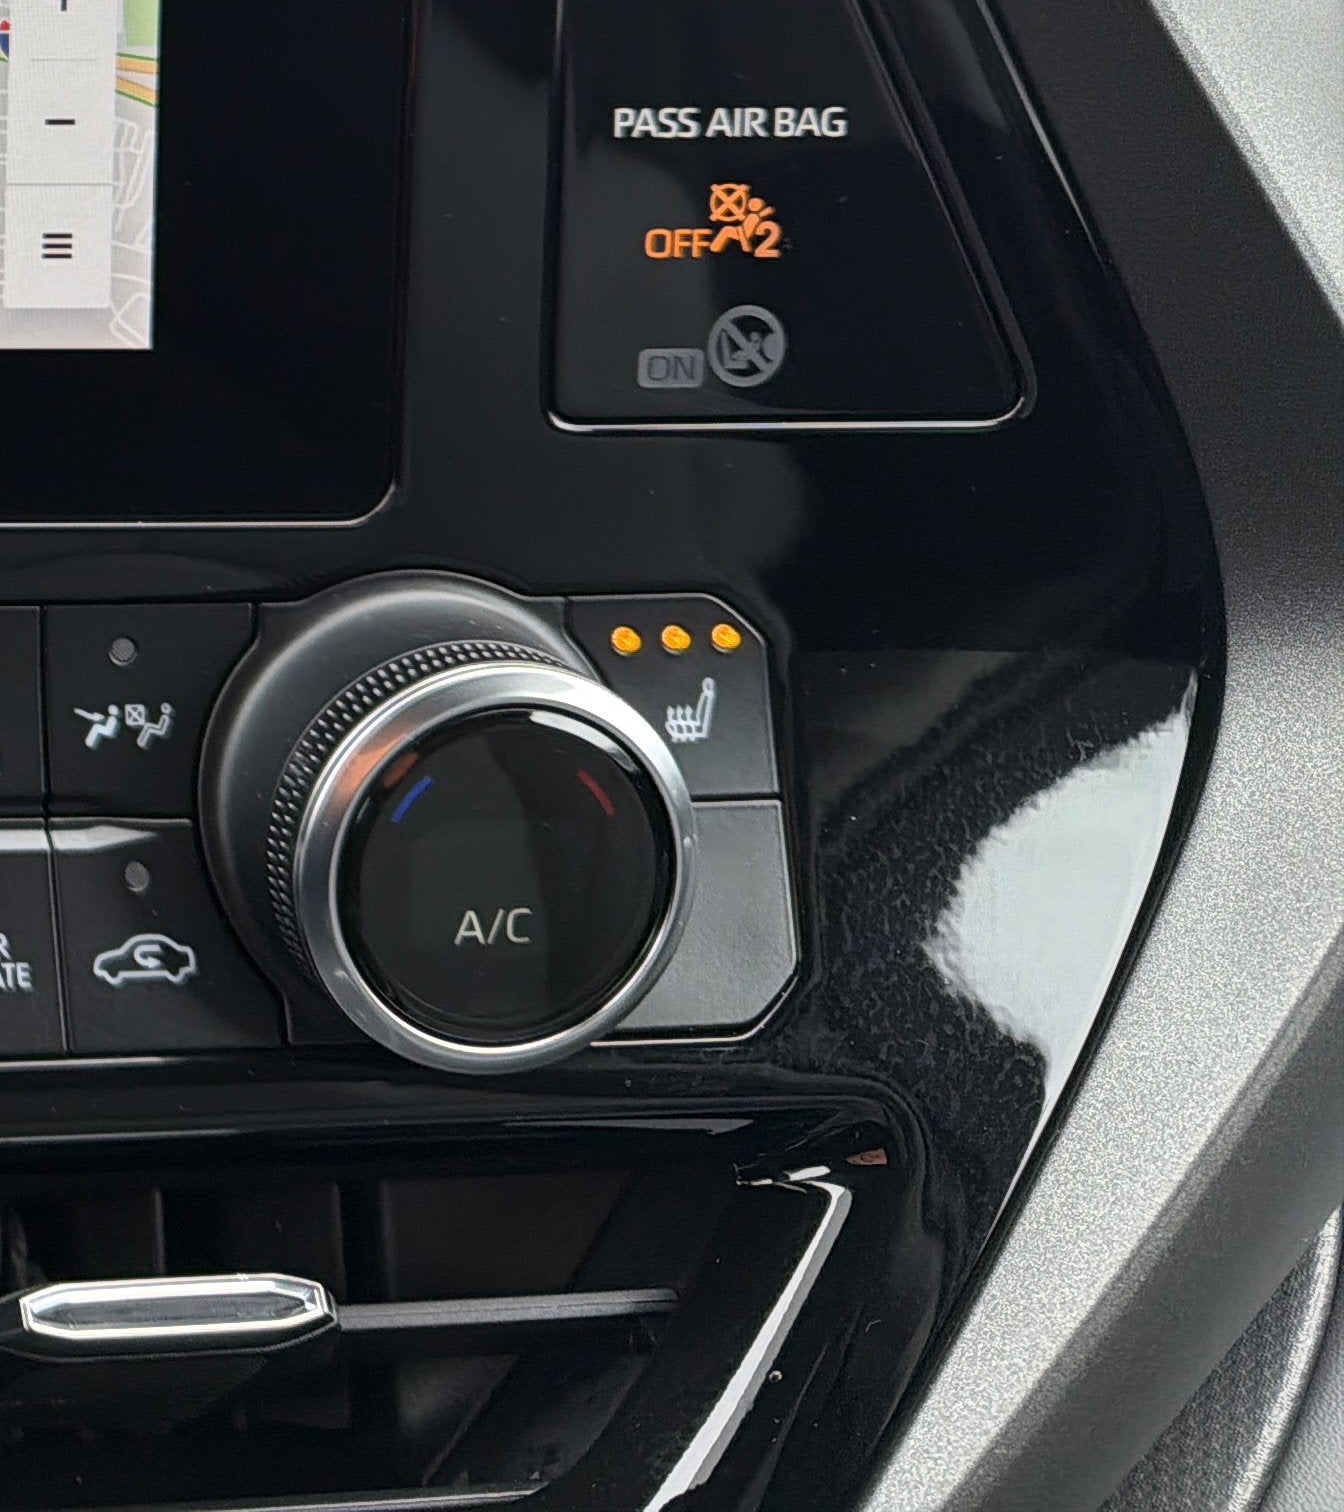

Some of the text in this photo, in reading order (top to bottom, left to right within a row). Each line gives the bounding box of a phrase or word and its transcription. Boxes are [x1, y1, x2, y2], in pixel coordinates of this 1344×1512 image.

[613, 106, 848, 139] PASS AIR BAG
[644, 227, 714, 259] OFF
[645, 352, 697, 382] ON
[453, 907, 534, 946] A/C
